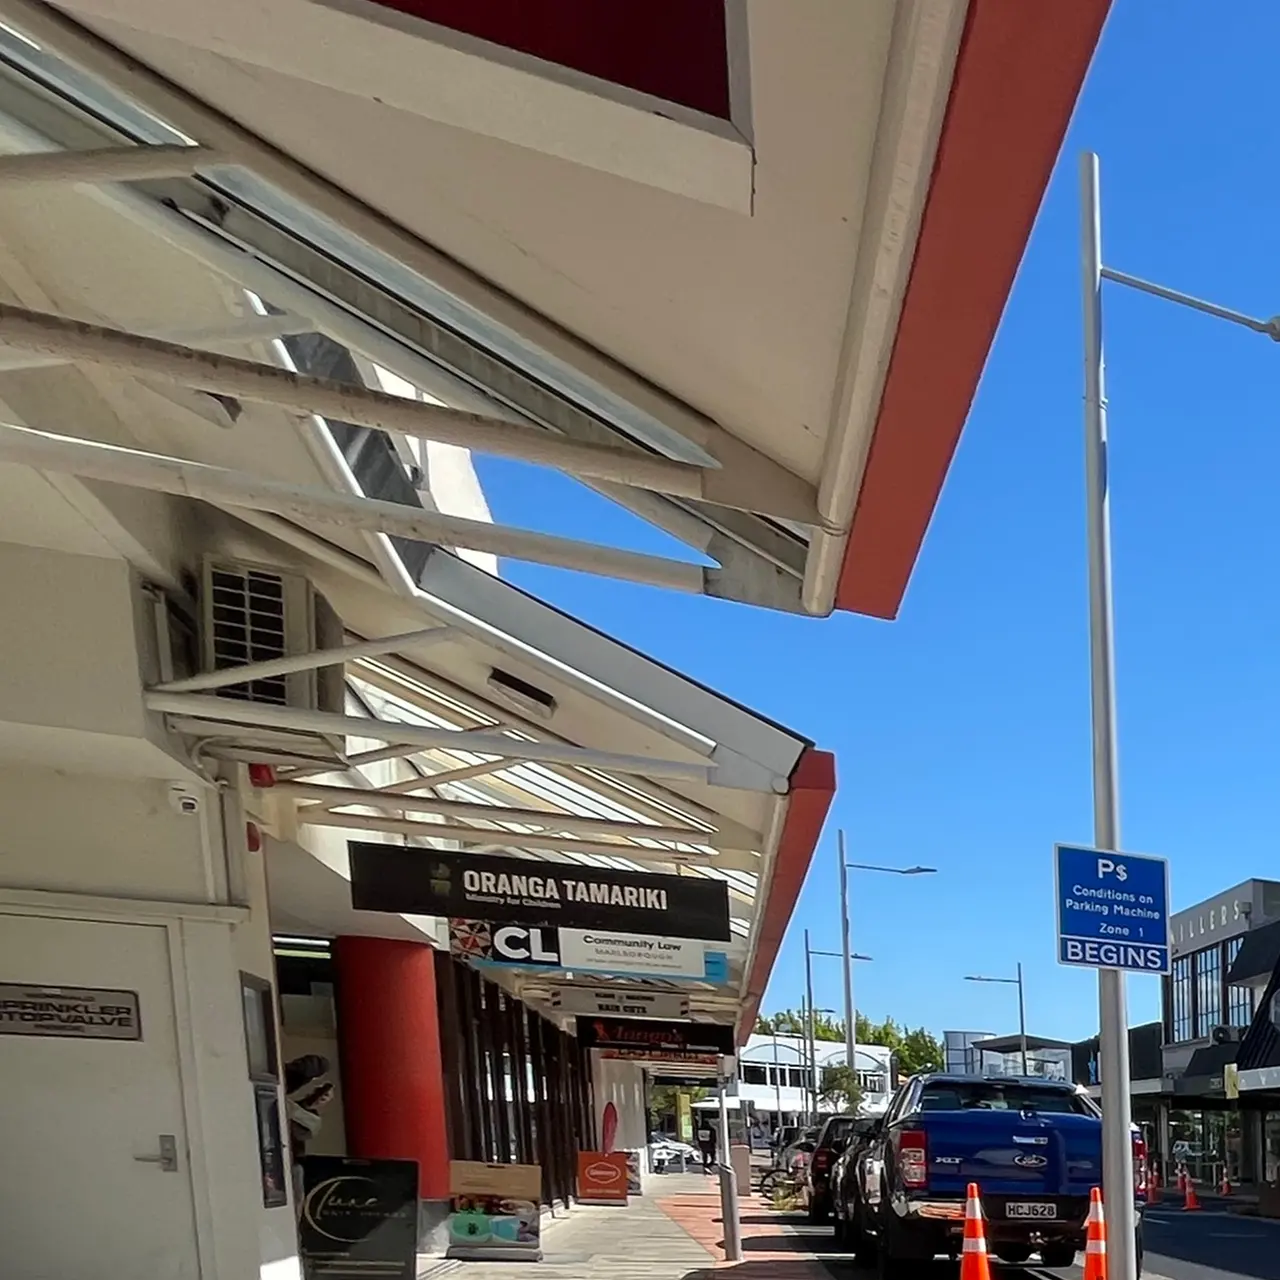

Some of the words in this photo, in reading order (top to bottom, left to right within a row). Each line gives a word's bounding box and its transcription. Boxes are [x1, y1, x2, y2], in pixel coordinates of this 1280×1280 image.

[463, 869, 560, 901] ORANGA
[562, 879, 668, 911] TAMARIKI
[1072, 884, 1135, 902] Conditions
[1139, 894, 1154, 904] on
[1065, 898, 1109, 916] Parking
[1113, 904, 1160, 920] Machine
[1100, 922, 1130, 936] Zone
[1139, 927, 1144, 938] 1
[493, 925, 559, 963] CL
[583, 935, 655, 950] Community
[658, 942, 682, 951] Law
[1066, 941, 1162, 969] BEGINS
[0, 1000, 132, 1016] PRINKLER
[0, 1010, 133, 1027] TOPVALVE
[1007, 1204, 1055, 1217] HCJ628
